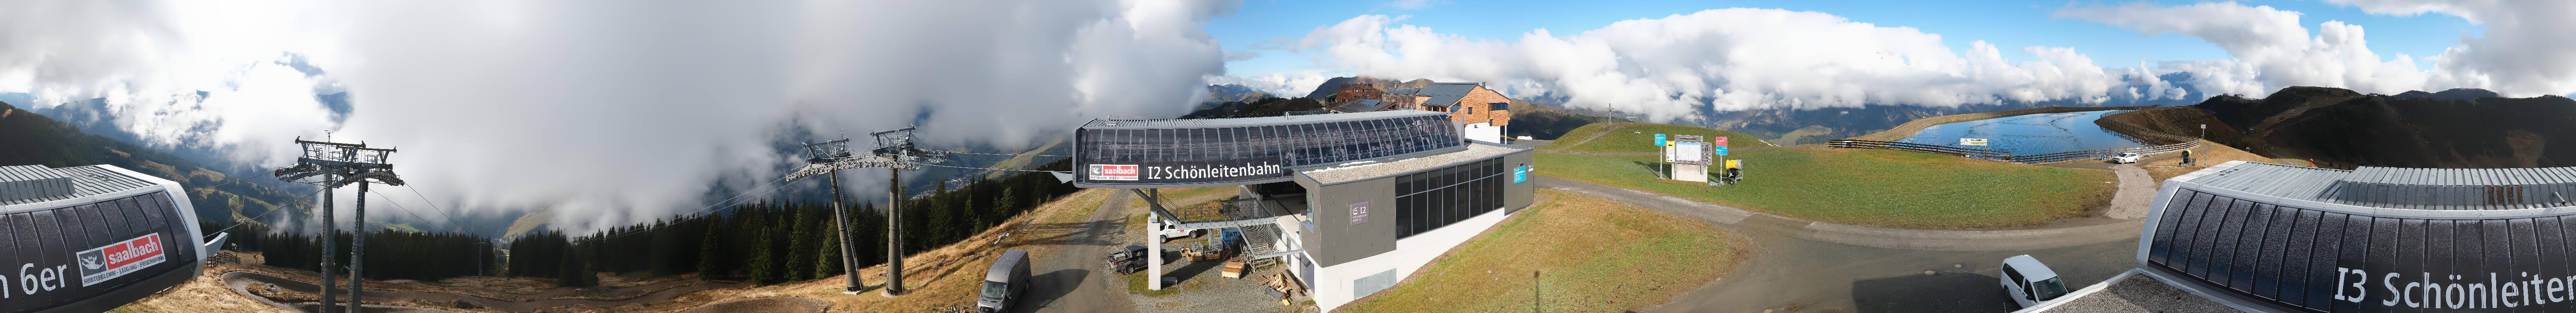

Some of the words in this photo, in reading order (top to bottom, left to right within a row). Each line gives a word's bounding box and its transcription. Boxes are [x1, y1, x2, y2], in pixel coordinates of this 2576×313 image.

[1105, 166, 1135, 174] saalbach
[1148, 166, 1161, 179] I2
[1165, 161, 1280, 179] Schönleitenbahn
[108, 236, 158, 264] saalbach
[21, 263, 67, 295] 6er
[120, 264, 137, 274] LEOGANG
[2334, 267, 2367, 303] I3
